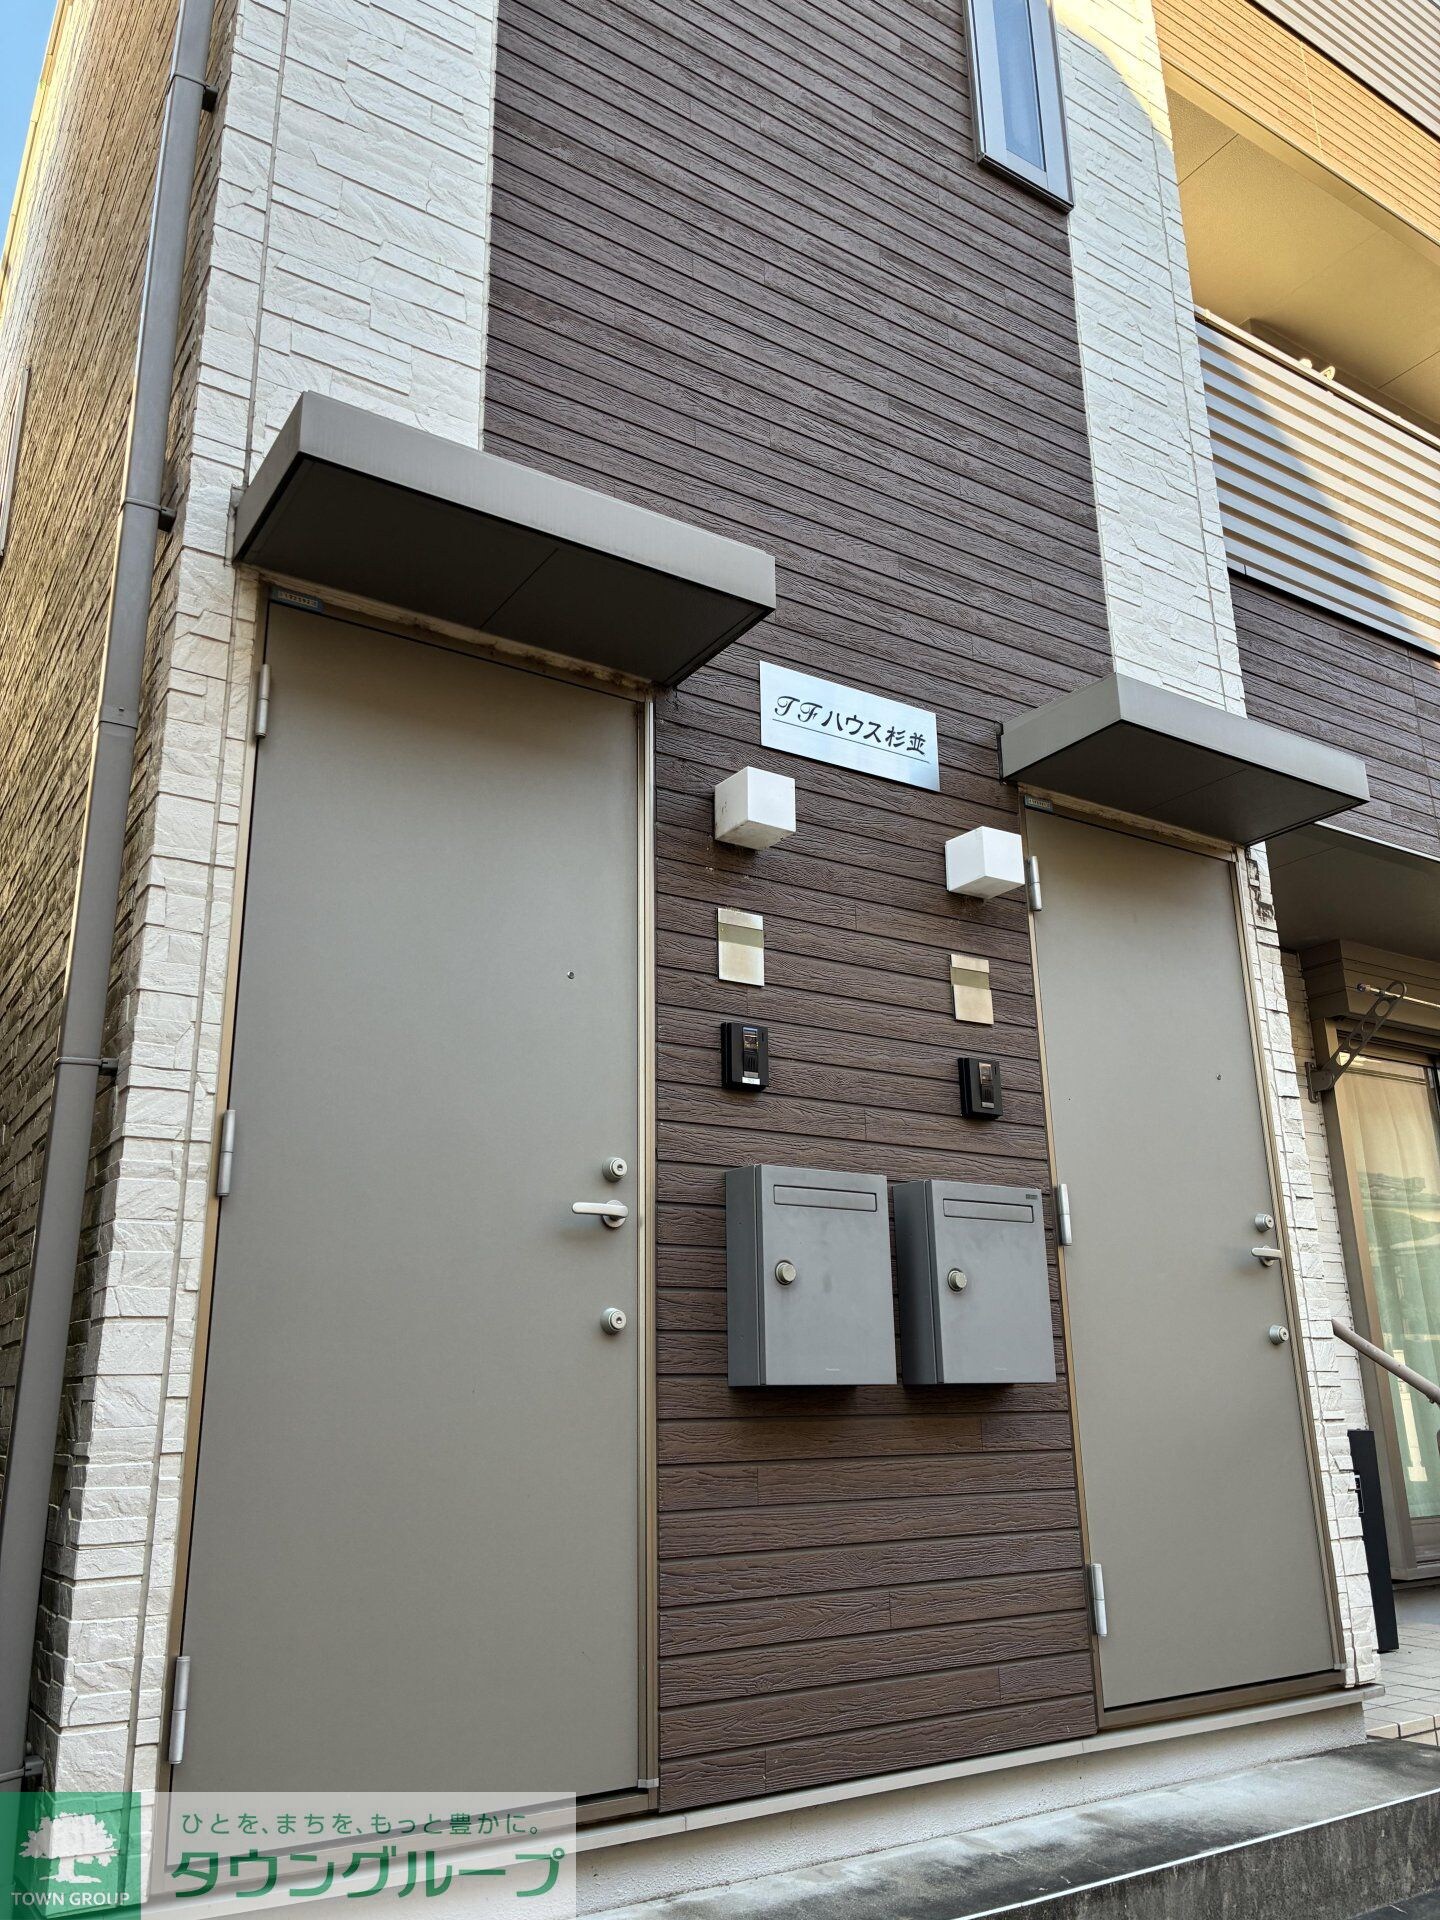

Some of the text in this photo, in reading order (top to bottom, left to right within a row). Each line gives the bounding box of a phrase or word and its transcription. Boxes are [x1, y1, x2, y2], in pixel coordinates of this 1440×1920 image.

[774, 694, 926, 755] TFハウス杉並
